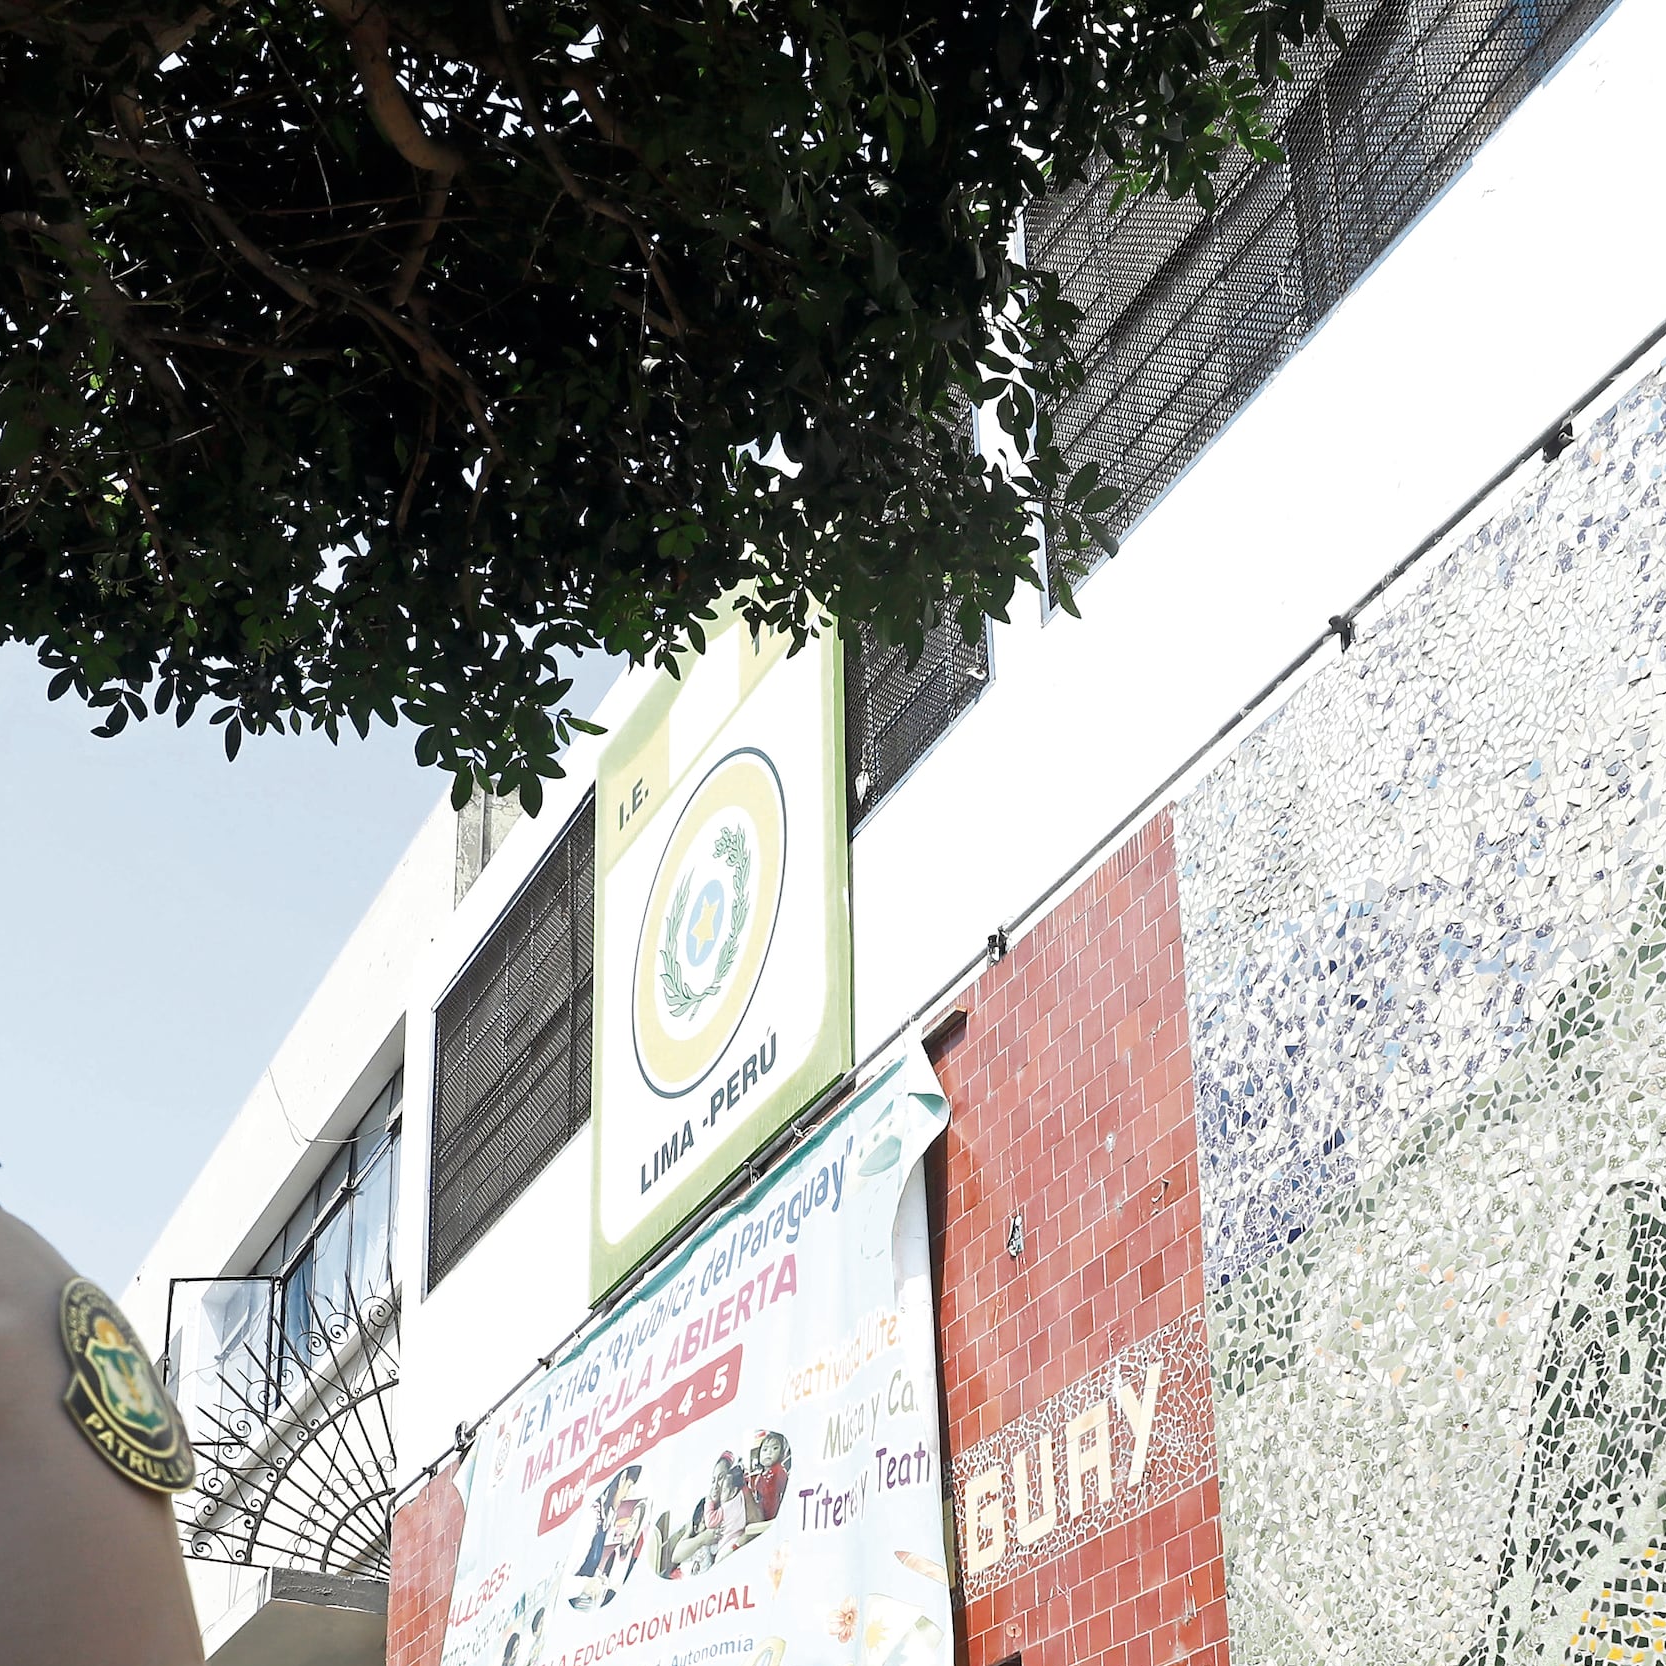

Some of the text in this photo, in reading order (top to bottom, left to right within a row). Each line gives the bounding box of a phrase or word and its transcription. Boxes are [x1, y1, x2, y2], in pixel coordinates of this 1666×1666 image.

[618, 783, 650, 832] I.E.
[640, 1117, 695, 1195] LIMA
[563, 1350, 602, 1412] 1146
[700, 1232, 737, 1296] del
[660, 1253, 797, 1381] ABIERTA
[647, 1406, 664, 1439] 3
[677, 1384, 694, 1417] 4
[712, 1364, 729, 1396] 5
[871, 1392, 880, 1441] y
[447, 1562, 511, 1628] ALLERES:
[679, 1585, 755, 1630] INICIAL
